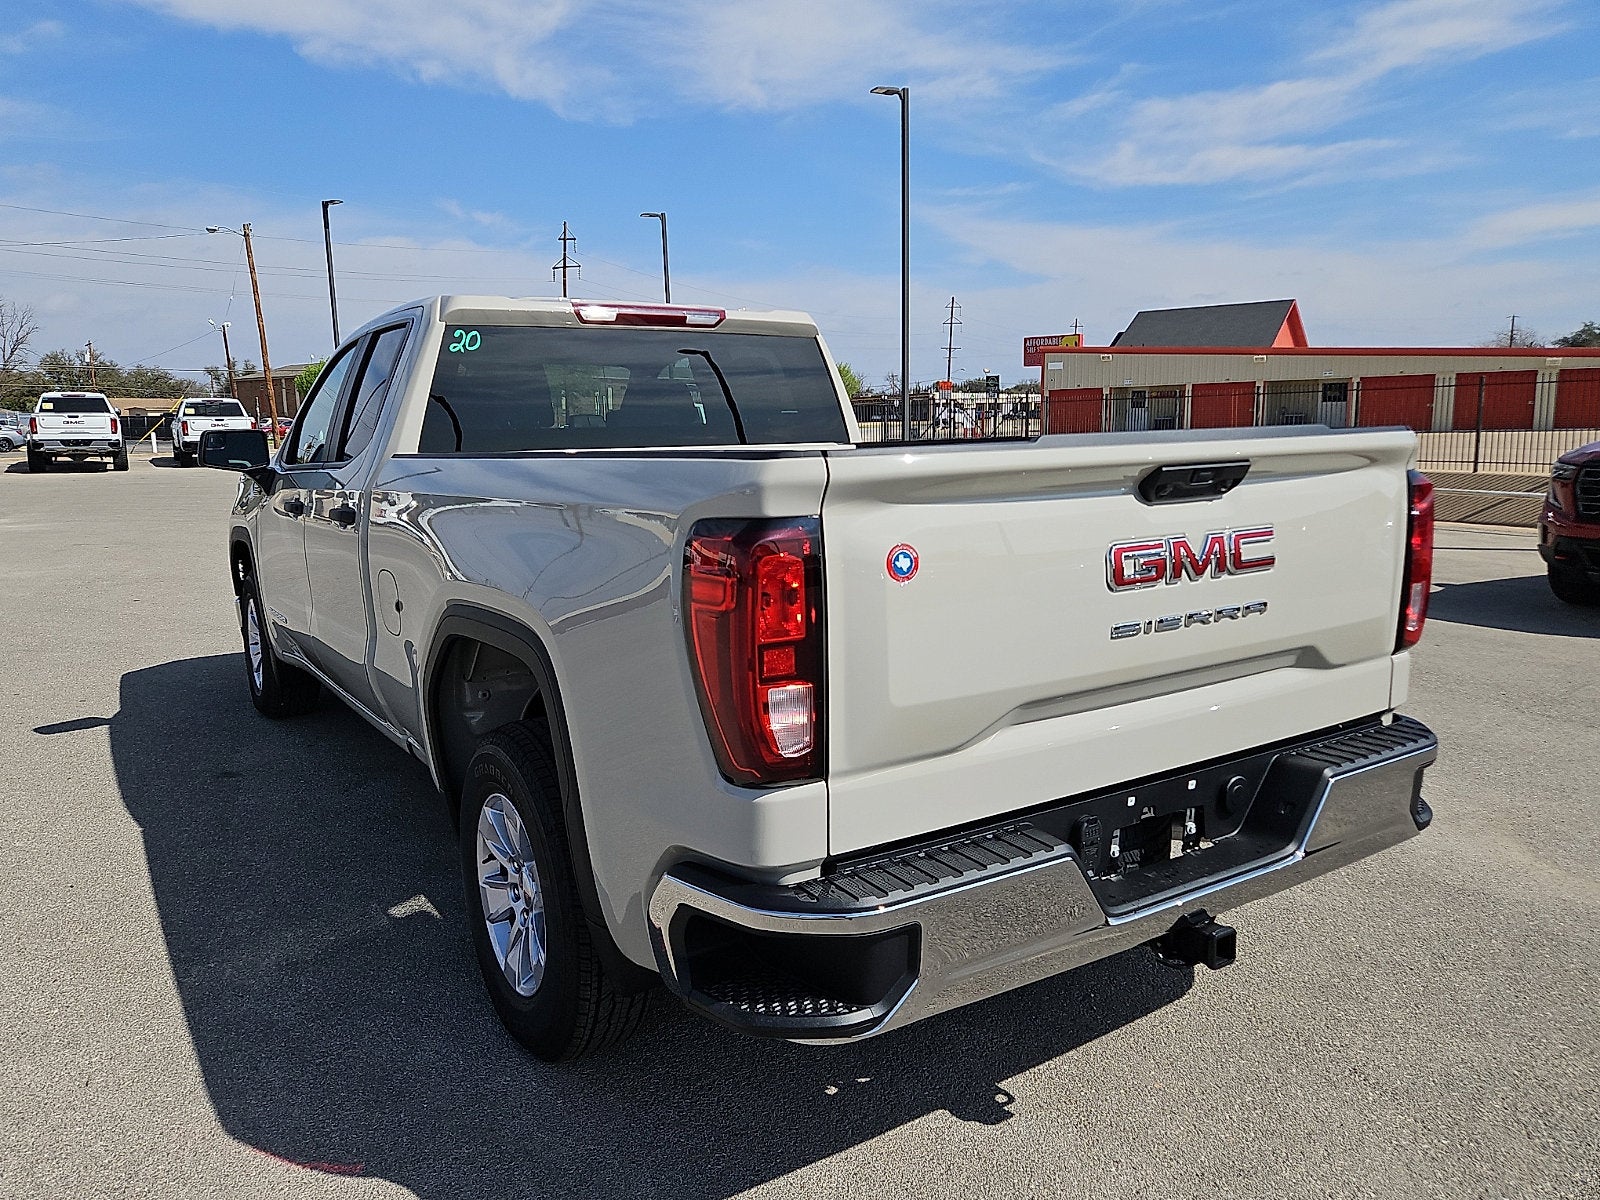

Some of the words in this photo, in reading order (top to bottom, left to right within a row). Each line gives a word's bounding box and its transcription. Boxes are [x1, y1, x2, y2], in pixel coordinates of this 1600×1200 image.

[448, 329, 481, 353] 20
[1025, 336, 1062, 347] AFFORDABLE
[1105, 523, 1276, 593] GMC
[1110, 601, 1269, 640] SIERRA
